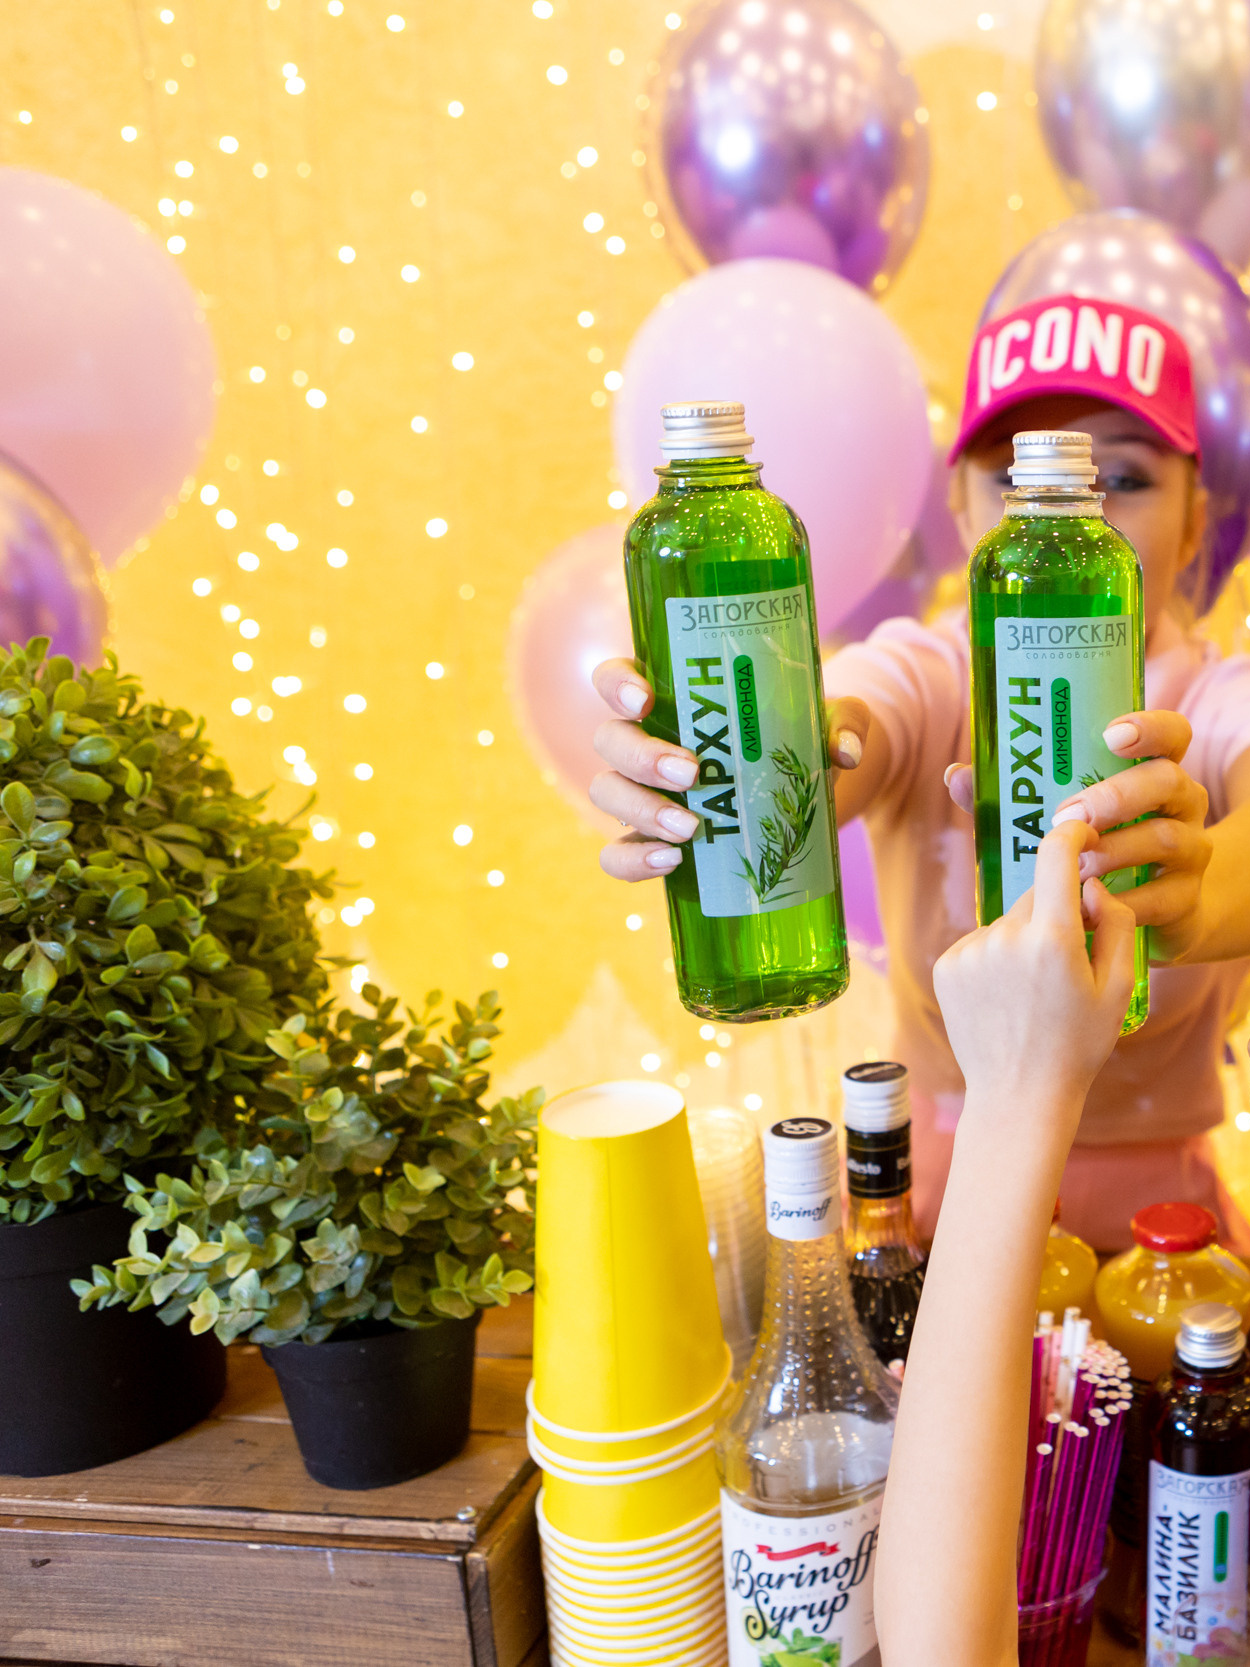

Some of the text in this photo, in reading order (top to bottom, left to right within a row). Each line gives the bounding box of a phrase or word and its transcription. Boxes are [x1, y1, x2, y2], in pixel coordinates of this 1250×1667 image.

[978, 305, 1166, 409] ICONO
[680, 593, 804, 632] ЗАГОРСКАЯ
[1007, 622, 1127, 651] ЗАГОРСКАЯ
[686, 656, 741, 844] ТАРХУН
[1008, 677, 1045, 862] ТАРХУН
[769, 1197, 832, 1221] Barinoff
[729, 1524, 881, 1599] Barinoff
[1154, 1504, 1174, 1635] МАЛИНА-
[1177, 1511, 1201, 1641] БАЗИЛИК
[745, 1589, 849, 1640] Syrup
